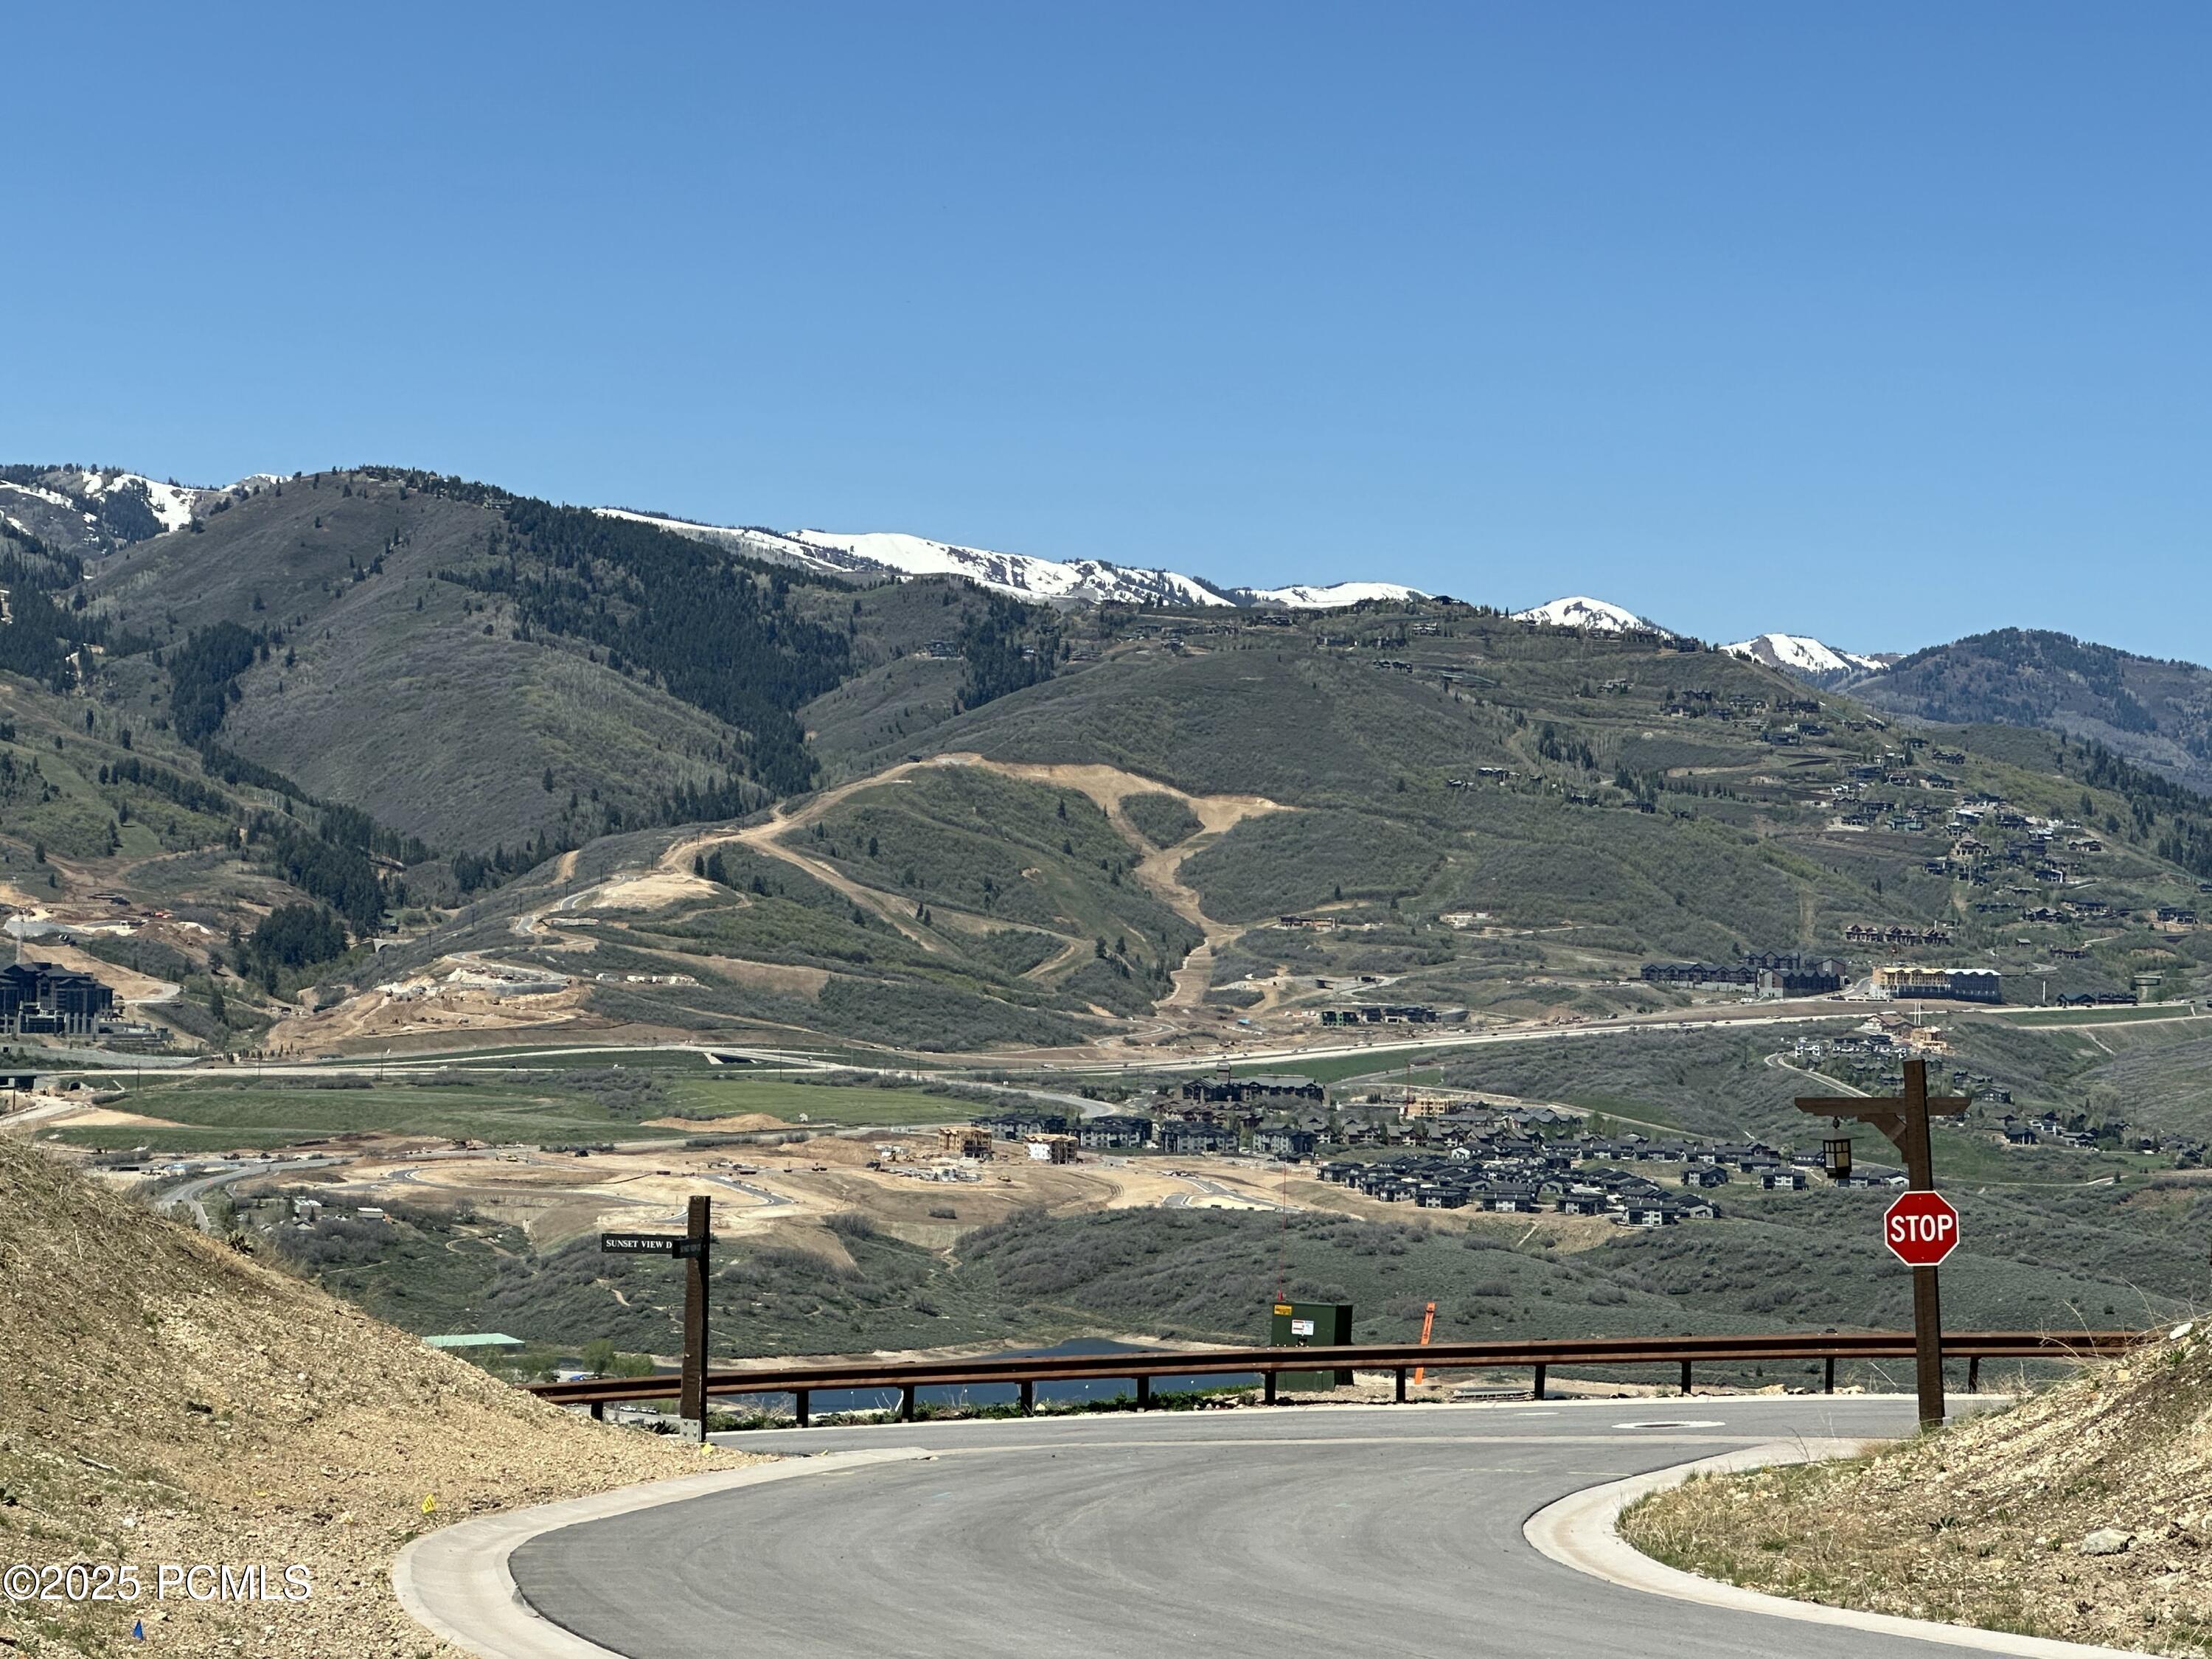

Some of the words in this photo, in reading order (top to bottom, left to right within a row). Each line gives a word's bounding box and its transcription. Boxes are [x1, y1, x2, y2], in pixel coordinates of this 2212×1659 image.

[1891, 1214, 1953, 1242] STOP
[606, 1239, 639, 1248] SUNSET
[641, 1240, 664, 1249] VIEW
